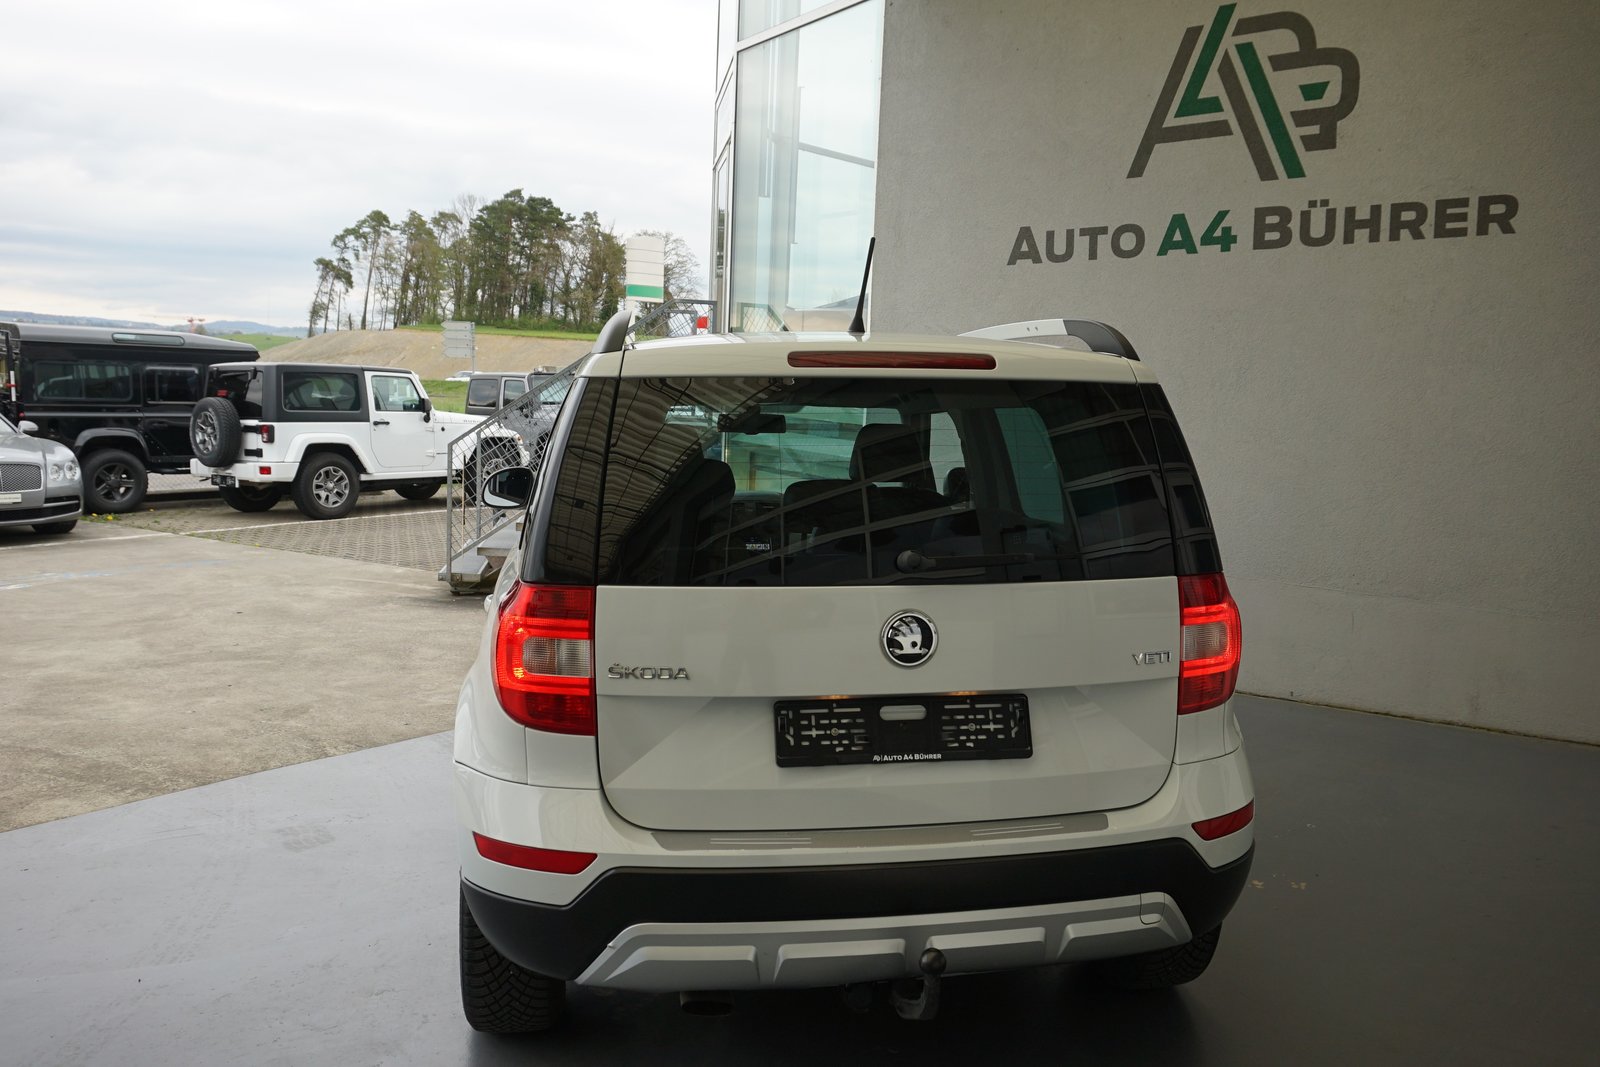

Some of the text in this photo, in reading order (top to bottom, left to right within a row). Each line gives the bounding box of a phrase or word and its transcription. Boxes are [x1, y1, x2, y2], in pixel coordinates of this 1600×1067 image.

[1007, 193, 1520, 266] AUTO A4 BÜHRER
[1132, 651, 1171, 665] YETI
[608, 663, 690, 680] ŠKODA
[903, 753, 913, 761] A4
